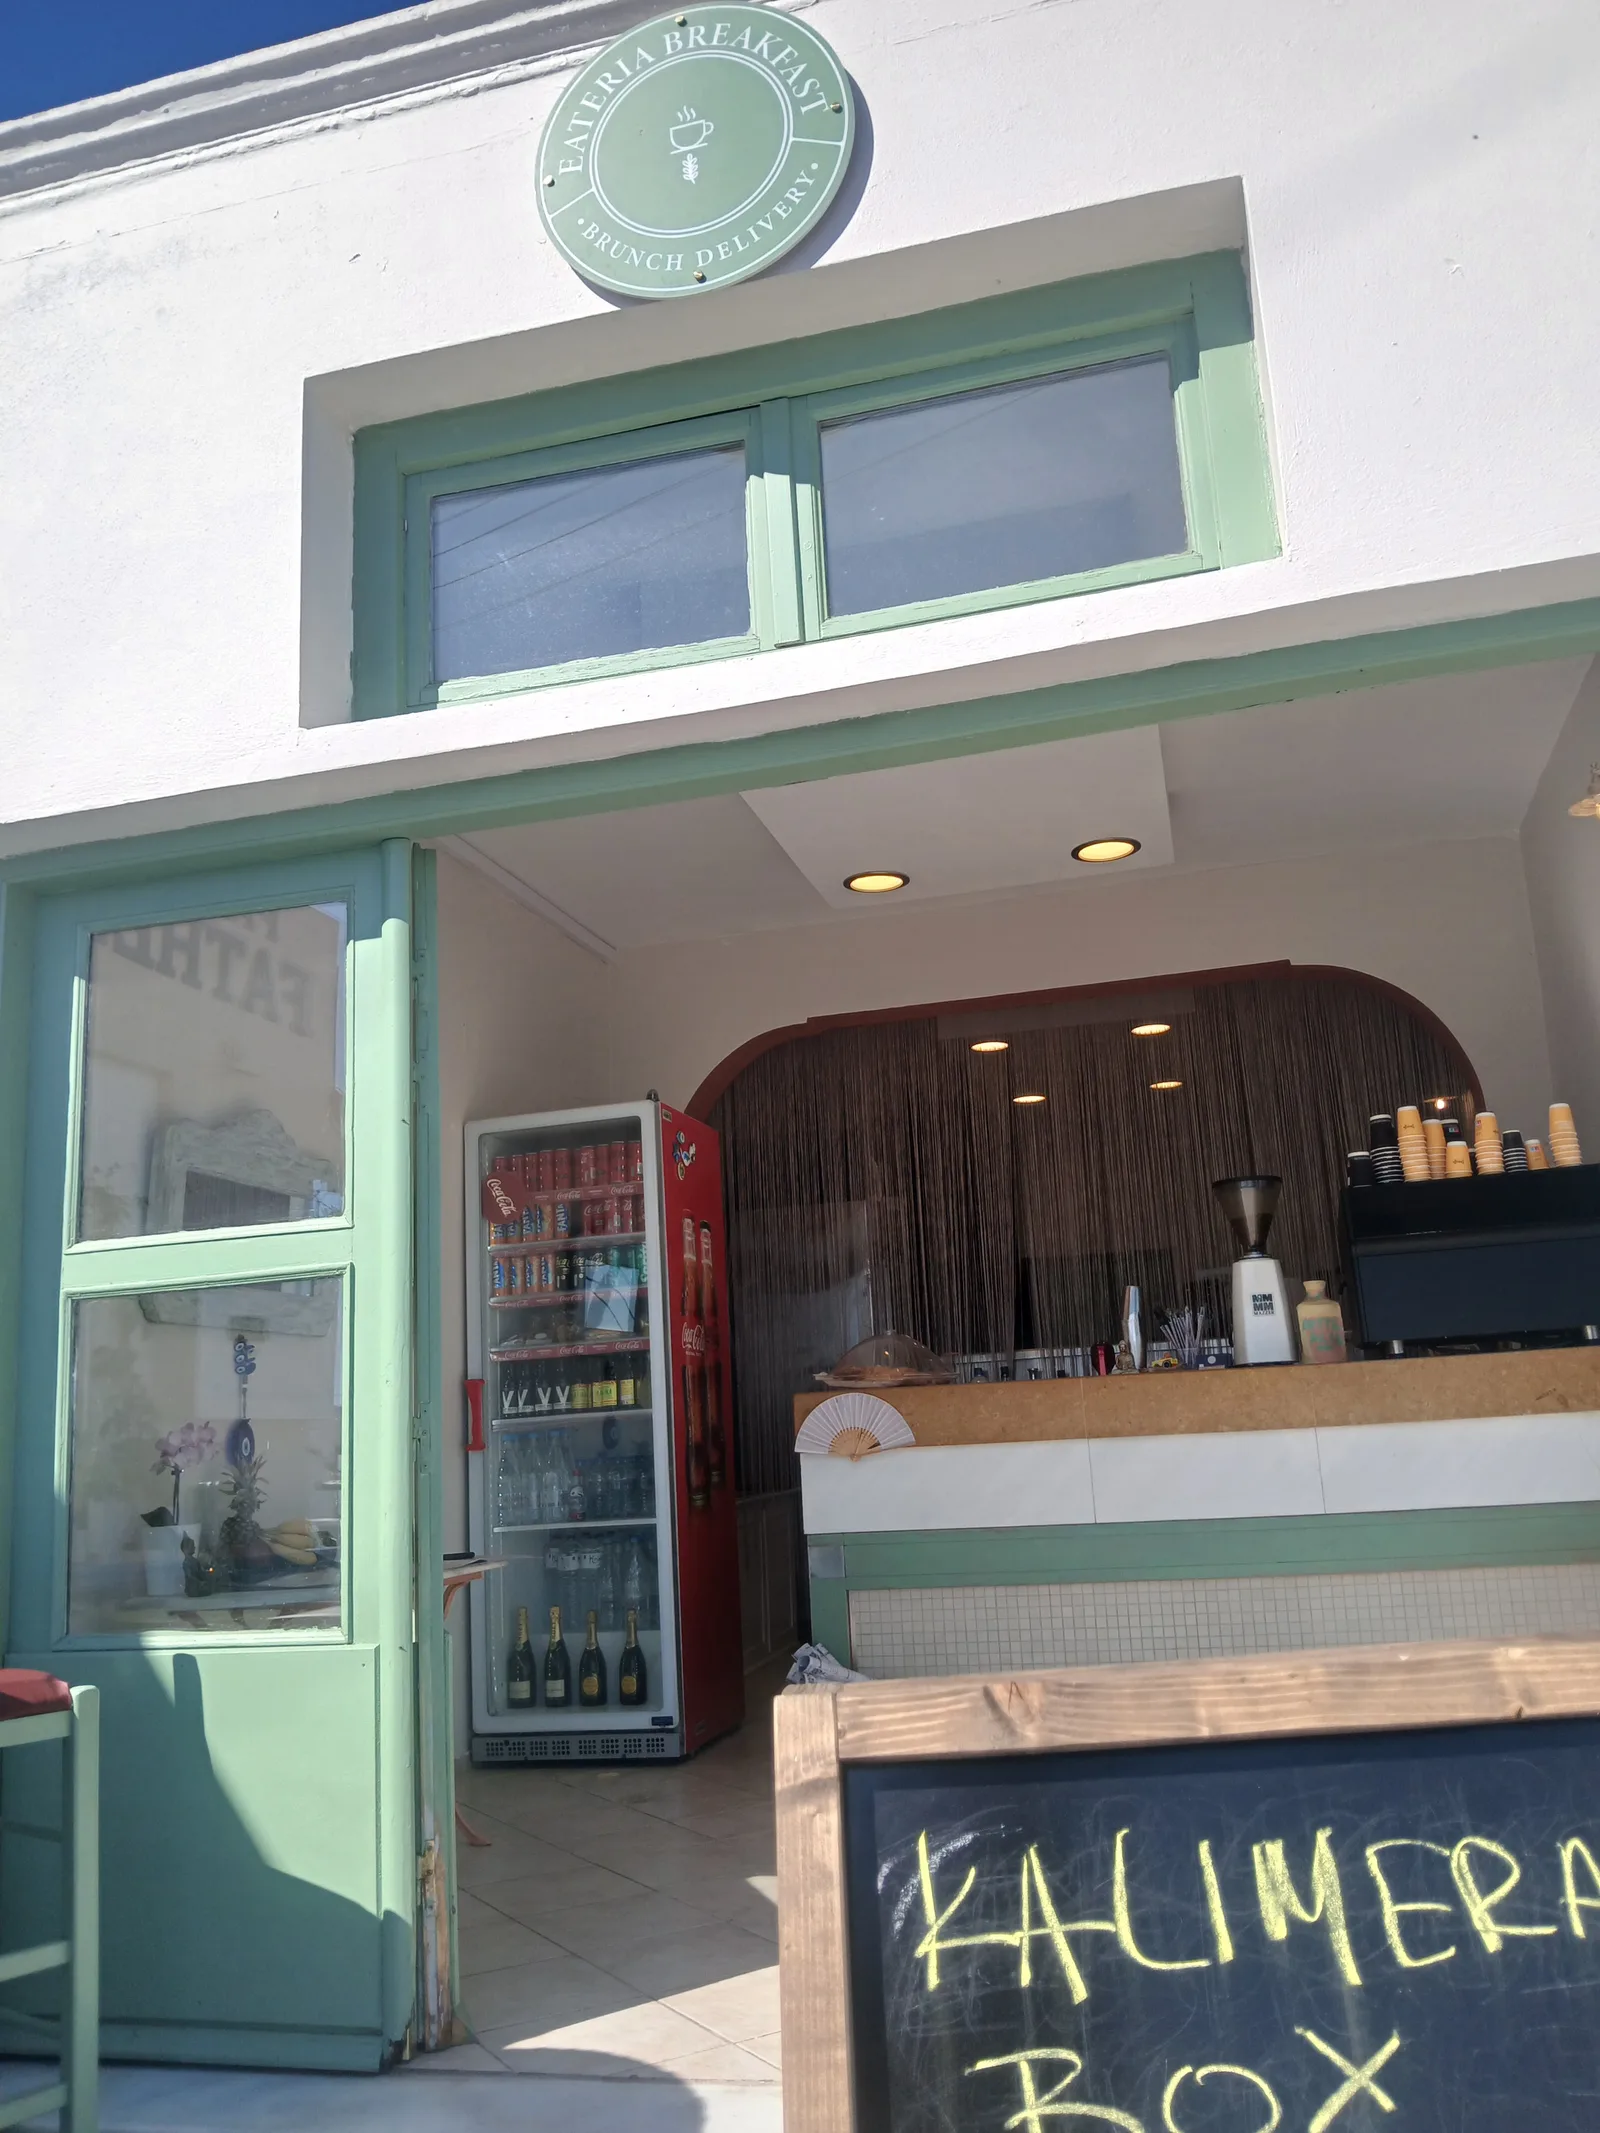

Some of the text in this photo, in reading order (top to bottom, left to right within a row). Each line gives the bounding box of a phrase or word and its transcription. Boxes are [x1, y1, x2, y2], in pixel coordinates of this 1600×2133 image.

[558, 22, 831, 176] EATERIA BREAKFAST
[581, 170, 817, 272] BRUNCH DELIVERY
[913, 1826, 1600, 2005] KALIMERA
